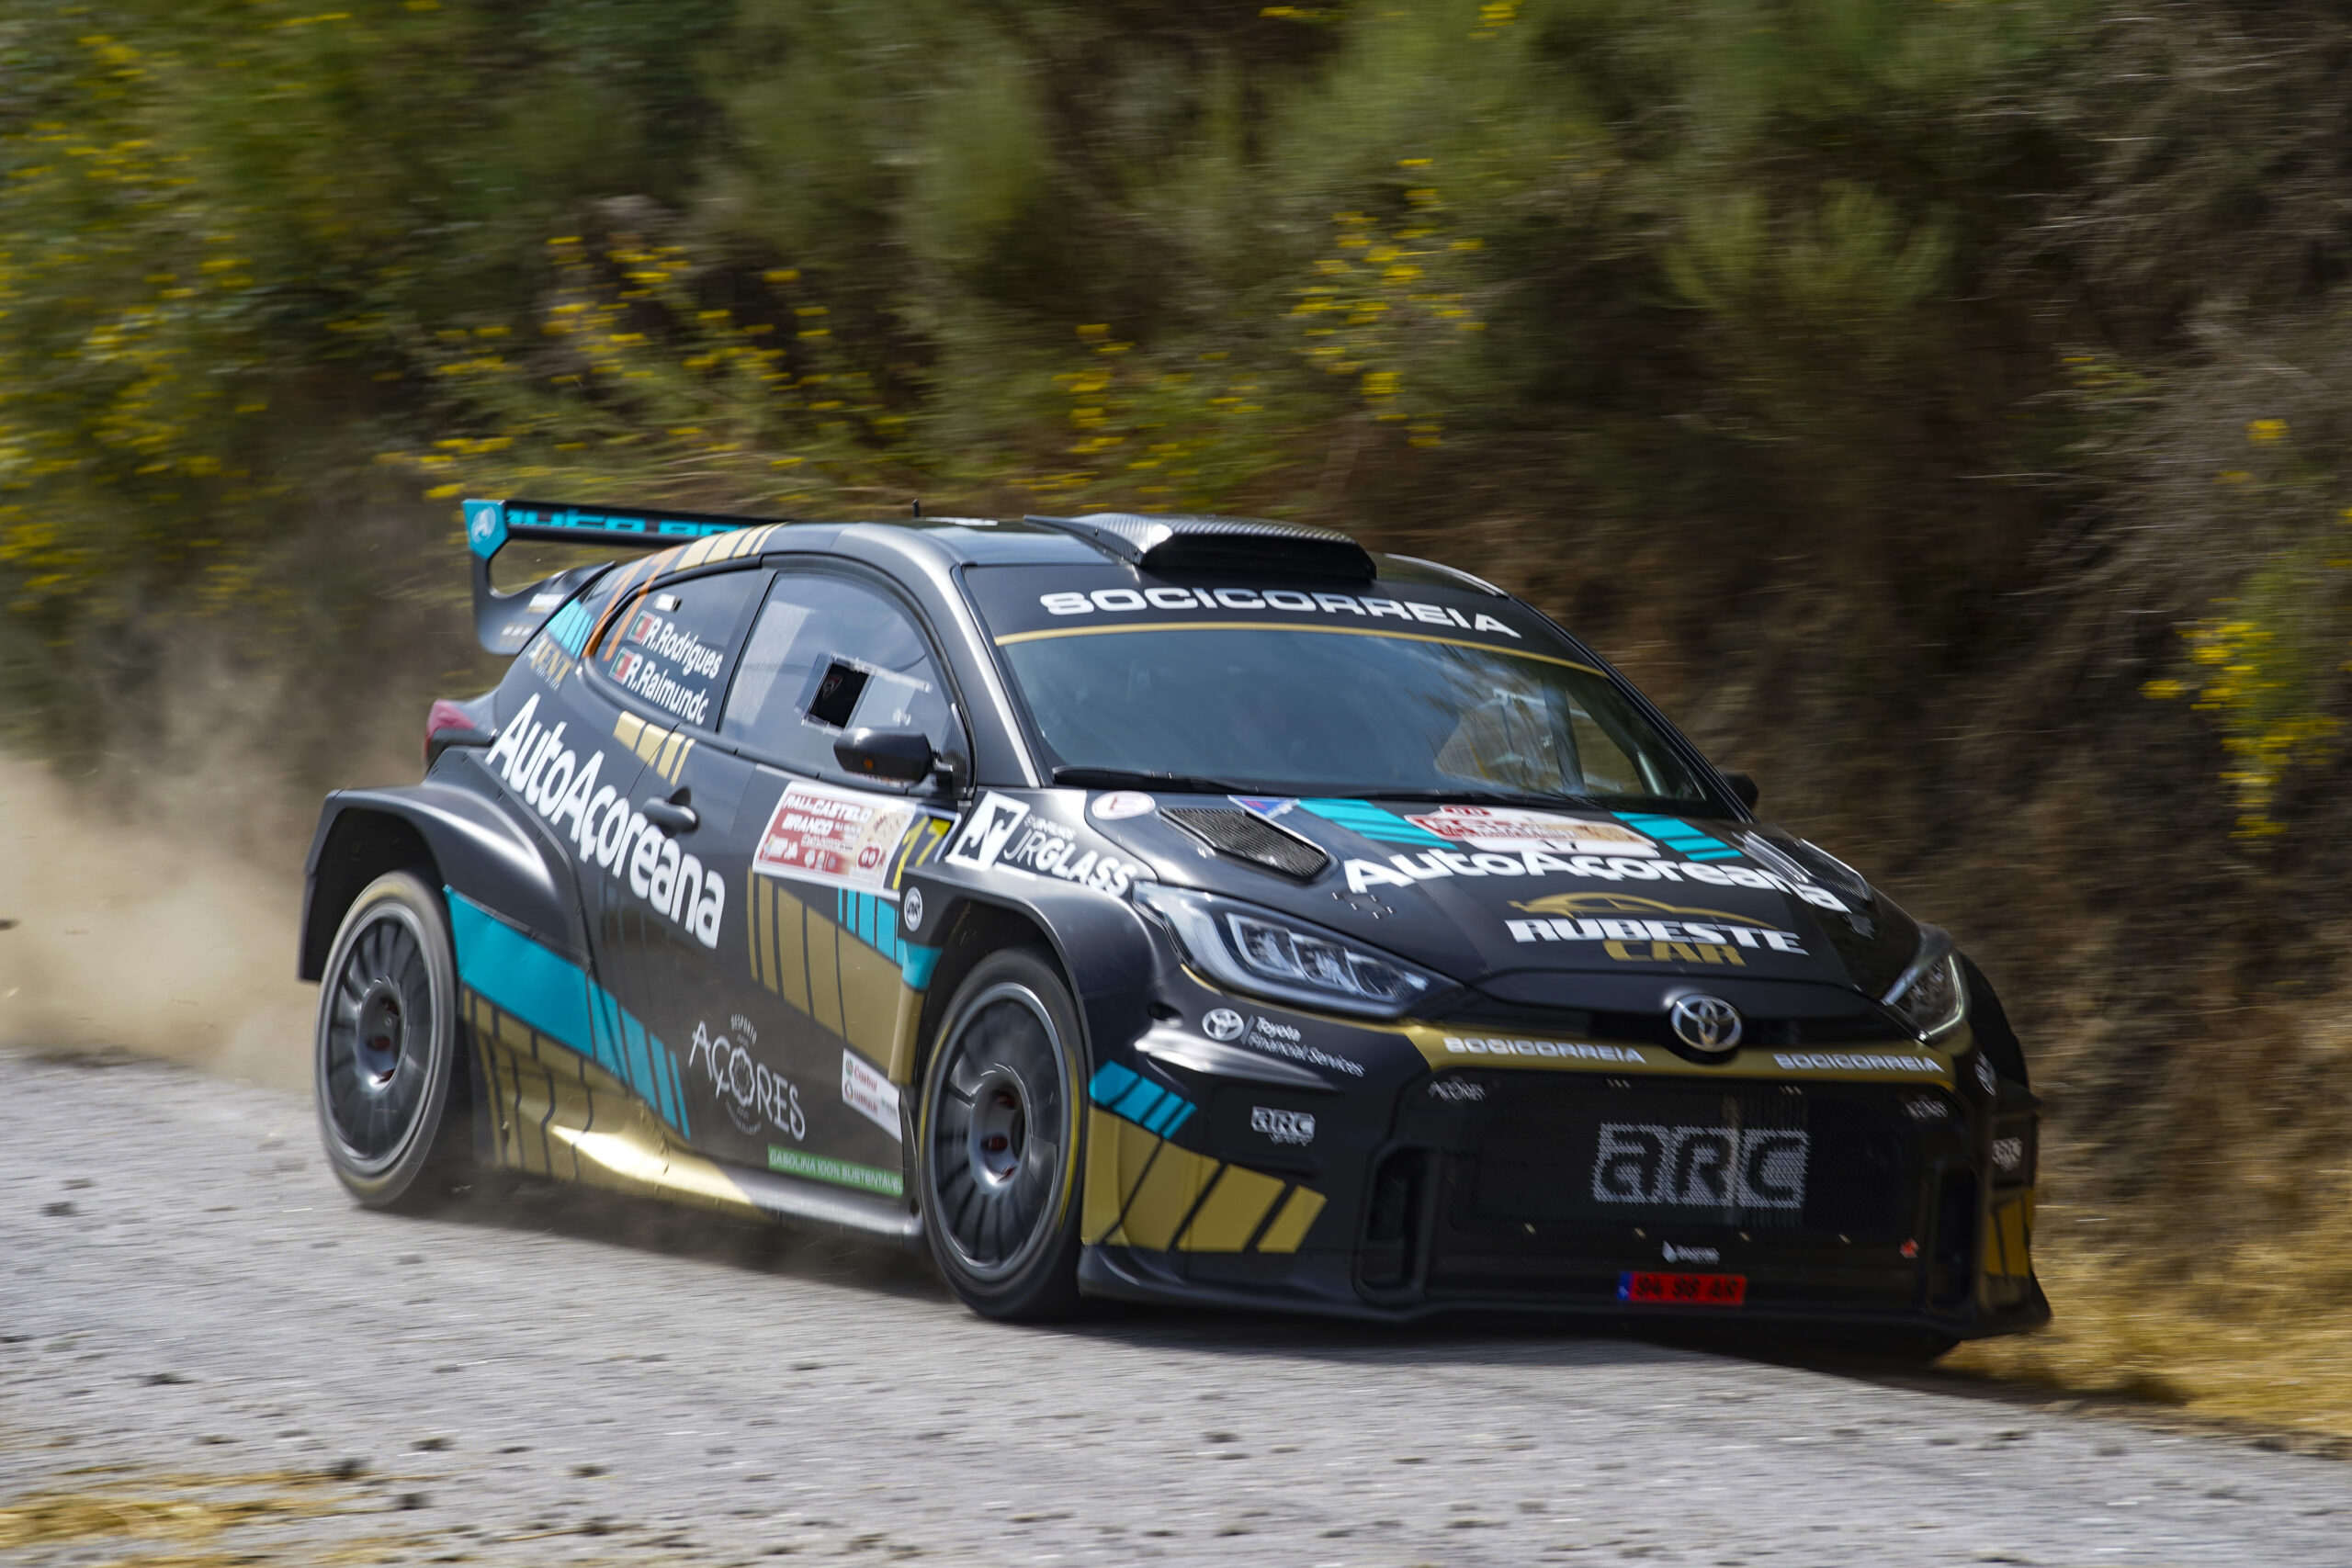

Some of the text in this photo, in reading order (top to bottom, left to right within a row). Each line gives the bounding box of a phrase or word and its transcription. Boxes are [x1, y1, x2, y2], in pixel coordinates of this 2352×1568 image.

[1040, 587, 1522, 639] SOCICORREIA
[642, 616, 724, 680] R.Rodrigues
[485, 693, 726, 949] AutoAçoreana
[1003, 829, 1138, 897] JRGLASS
[1345, 848, 1852, 914] AutoAçoreana
[1504, 918, 1810, 956] RUBESTE
[1603, 939, 1747, 966] CAR
[1443, 1037, 1647, 1065] SOCICORREIA
[689, 1021, 806, 1142] AÇORES
[769, 1149, 903, 1193] GASOLINA 100% SUSTENTÁVEL
